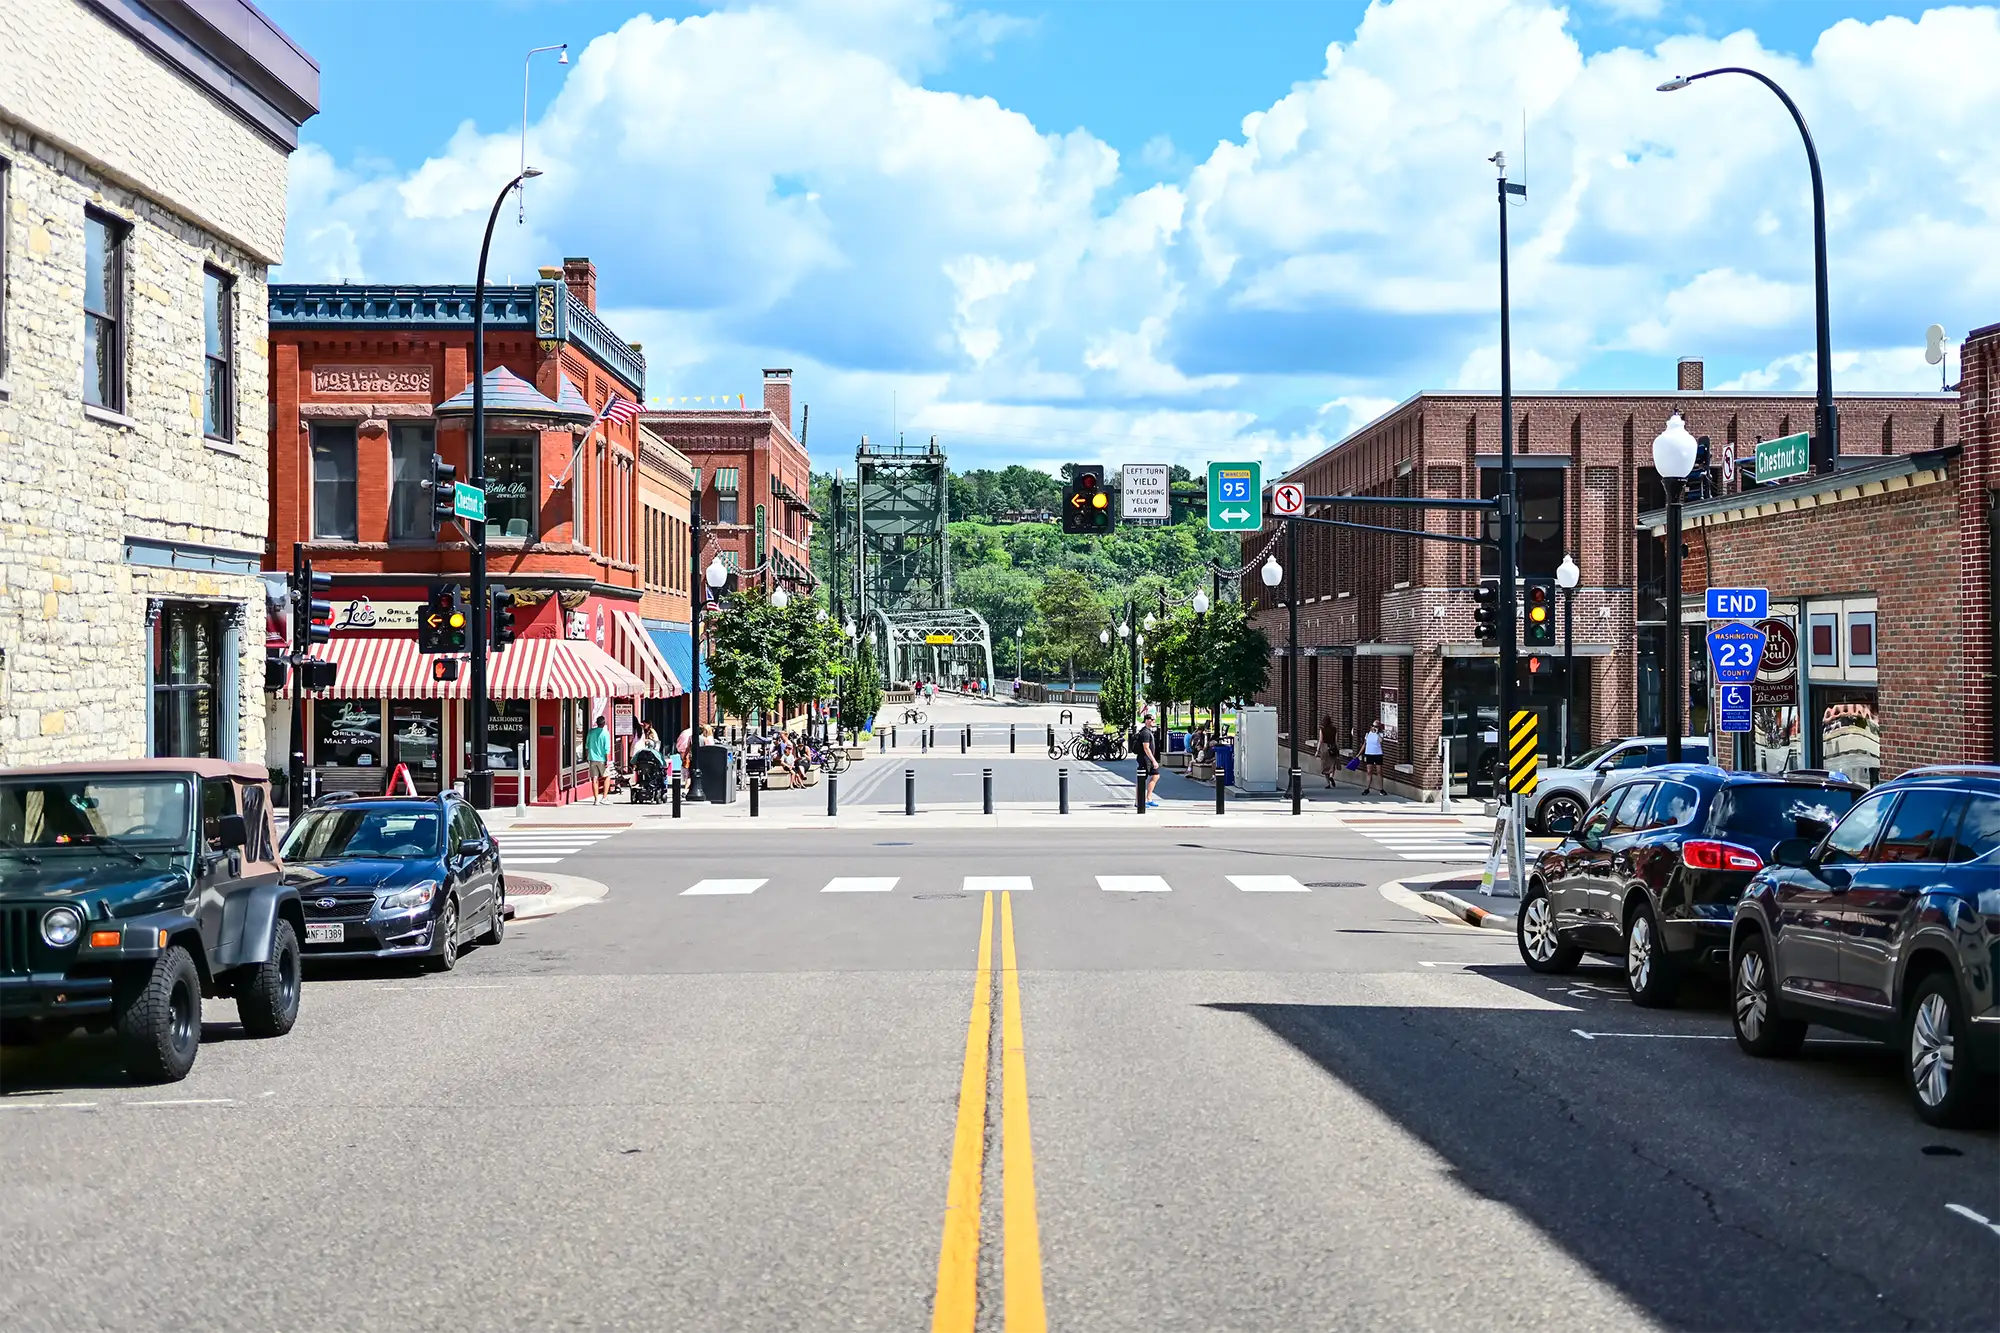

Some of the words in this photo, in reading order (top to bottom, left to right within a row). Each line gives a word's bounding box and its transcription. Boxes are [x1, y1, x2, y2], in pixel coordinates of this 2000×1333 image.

[316, 368, 380, 390] MOSIER
[352, 380, 391, 391] 1888
[1758, 445, 1795, 473] Chestnut
[1798, 449, 1805, 465] St
[1223, 482, 1245, 497] 95
[456, 489, 478, 512] Chestnut
[1717, 595, 1757, 613] END
[1720, 643, 1753, 667] 23
[1755, 692, 1789, 703] BEADS
